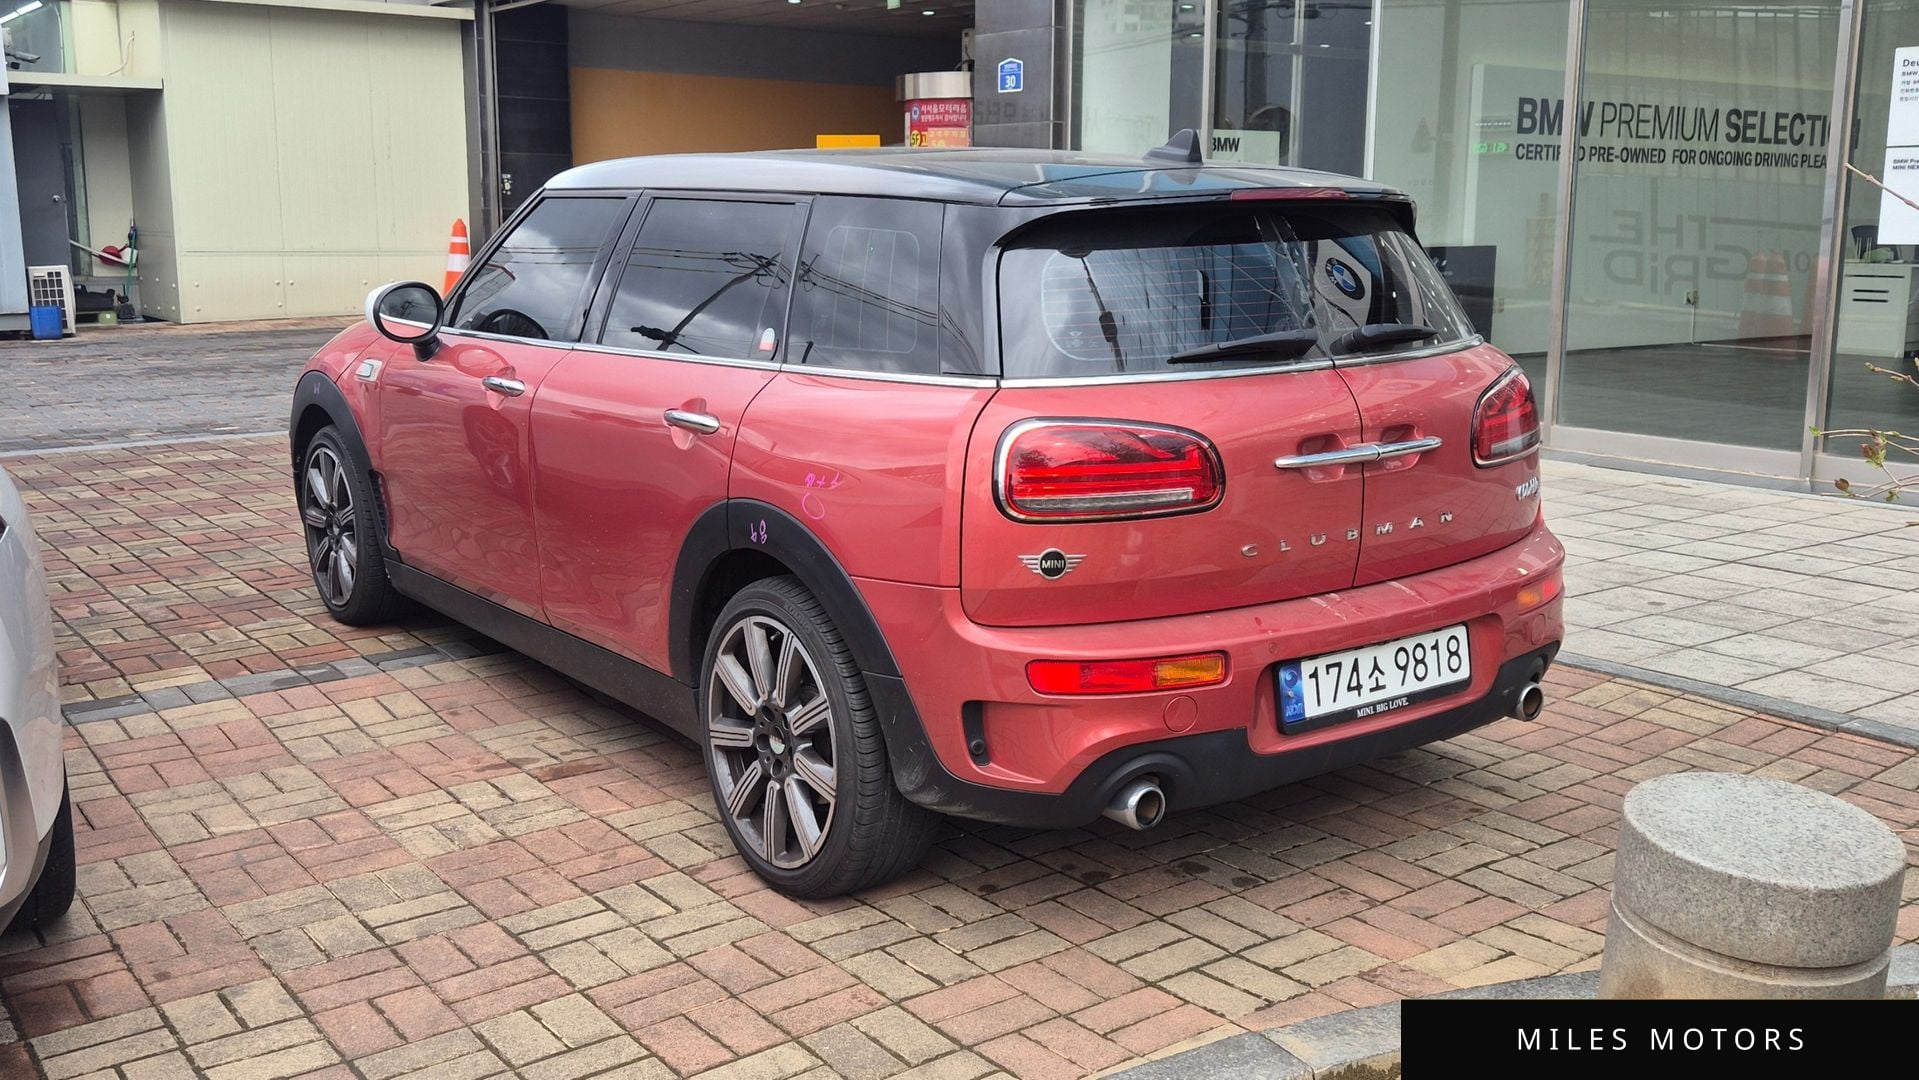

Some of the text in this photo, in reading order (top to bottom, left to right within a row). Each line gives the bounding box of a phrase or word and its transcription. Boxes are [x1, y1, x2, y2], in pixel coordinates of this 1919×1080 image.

[1004, 75, 1016, 88] 30
[1599, 101, 1720, 142] PREMIUM
[1725, 107, 1860, 150] SELECTI
[1515, 143, 1586, 162] CERTIFD
[1588, 146, 1666, 164] PRE-OWNED
[1672, 149, 1697, 165] FOR
[1699, 150, 1752, 167] ONGOING
[1754, 152, 1799, 168] DRIVING
[1240, 511, 1453, 557] CLUBMAN
[1041, 559, 1065, 569] MINI
[1308, 634, 1462, 707] 174소 9818
[1376, 702, 1389, 713] BIG
